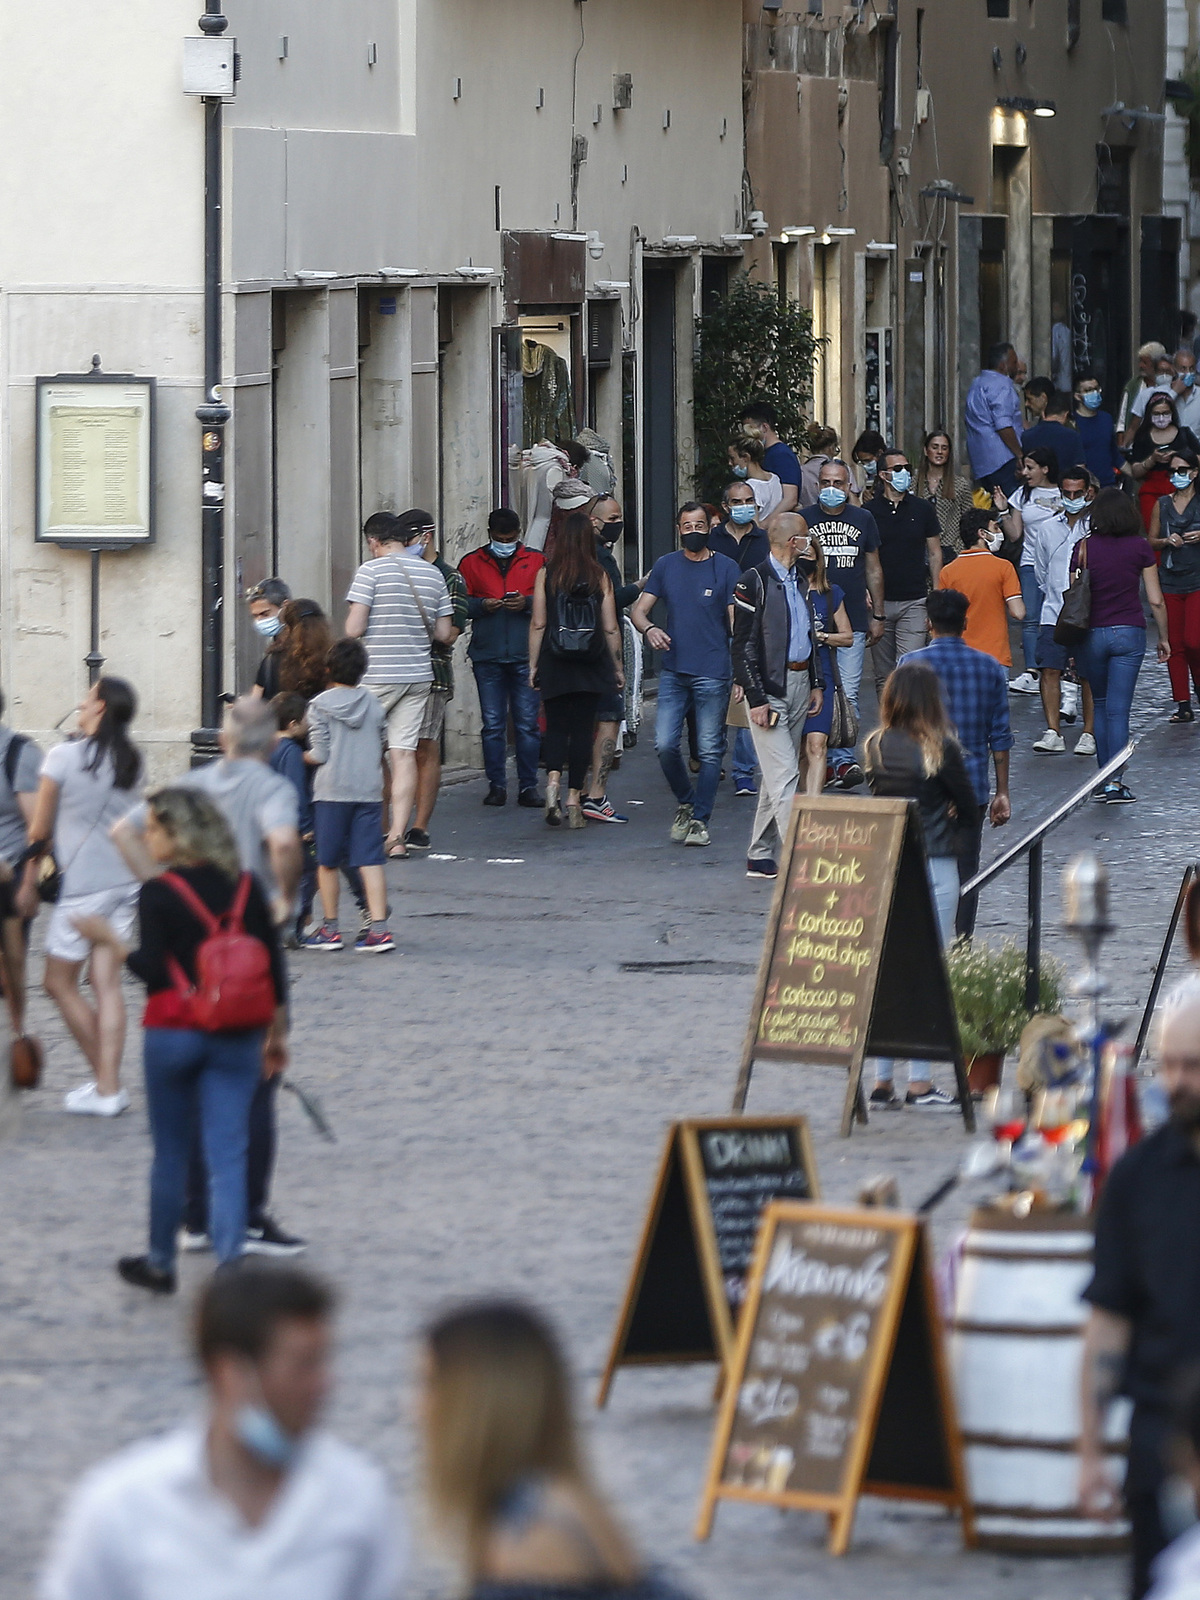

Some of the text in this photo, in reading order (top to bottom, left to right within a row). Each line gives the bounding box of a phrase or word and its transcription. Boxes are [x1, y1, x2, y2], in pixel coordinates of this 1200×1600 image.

[809, 521, 862, 542] BERCROMBIE
[836, 556, 856, 568] YORK
[800, 811, 878, 855] Happy Hour
[812, 853, 866, 887] Drink
